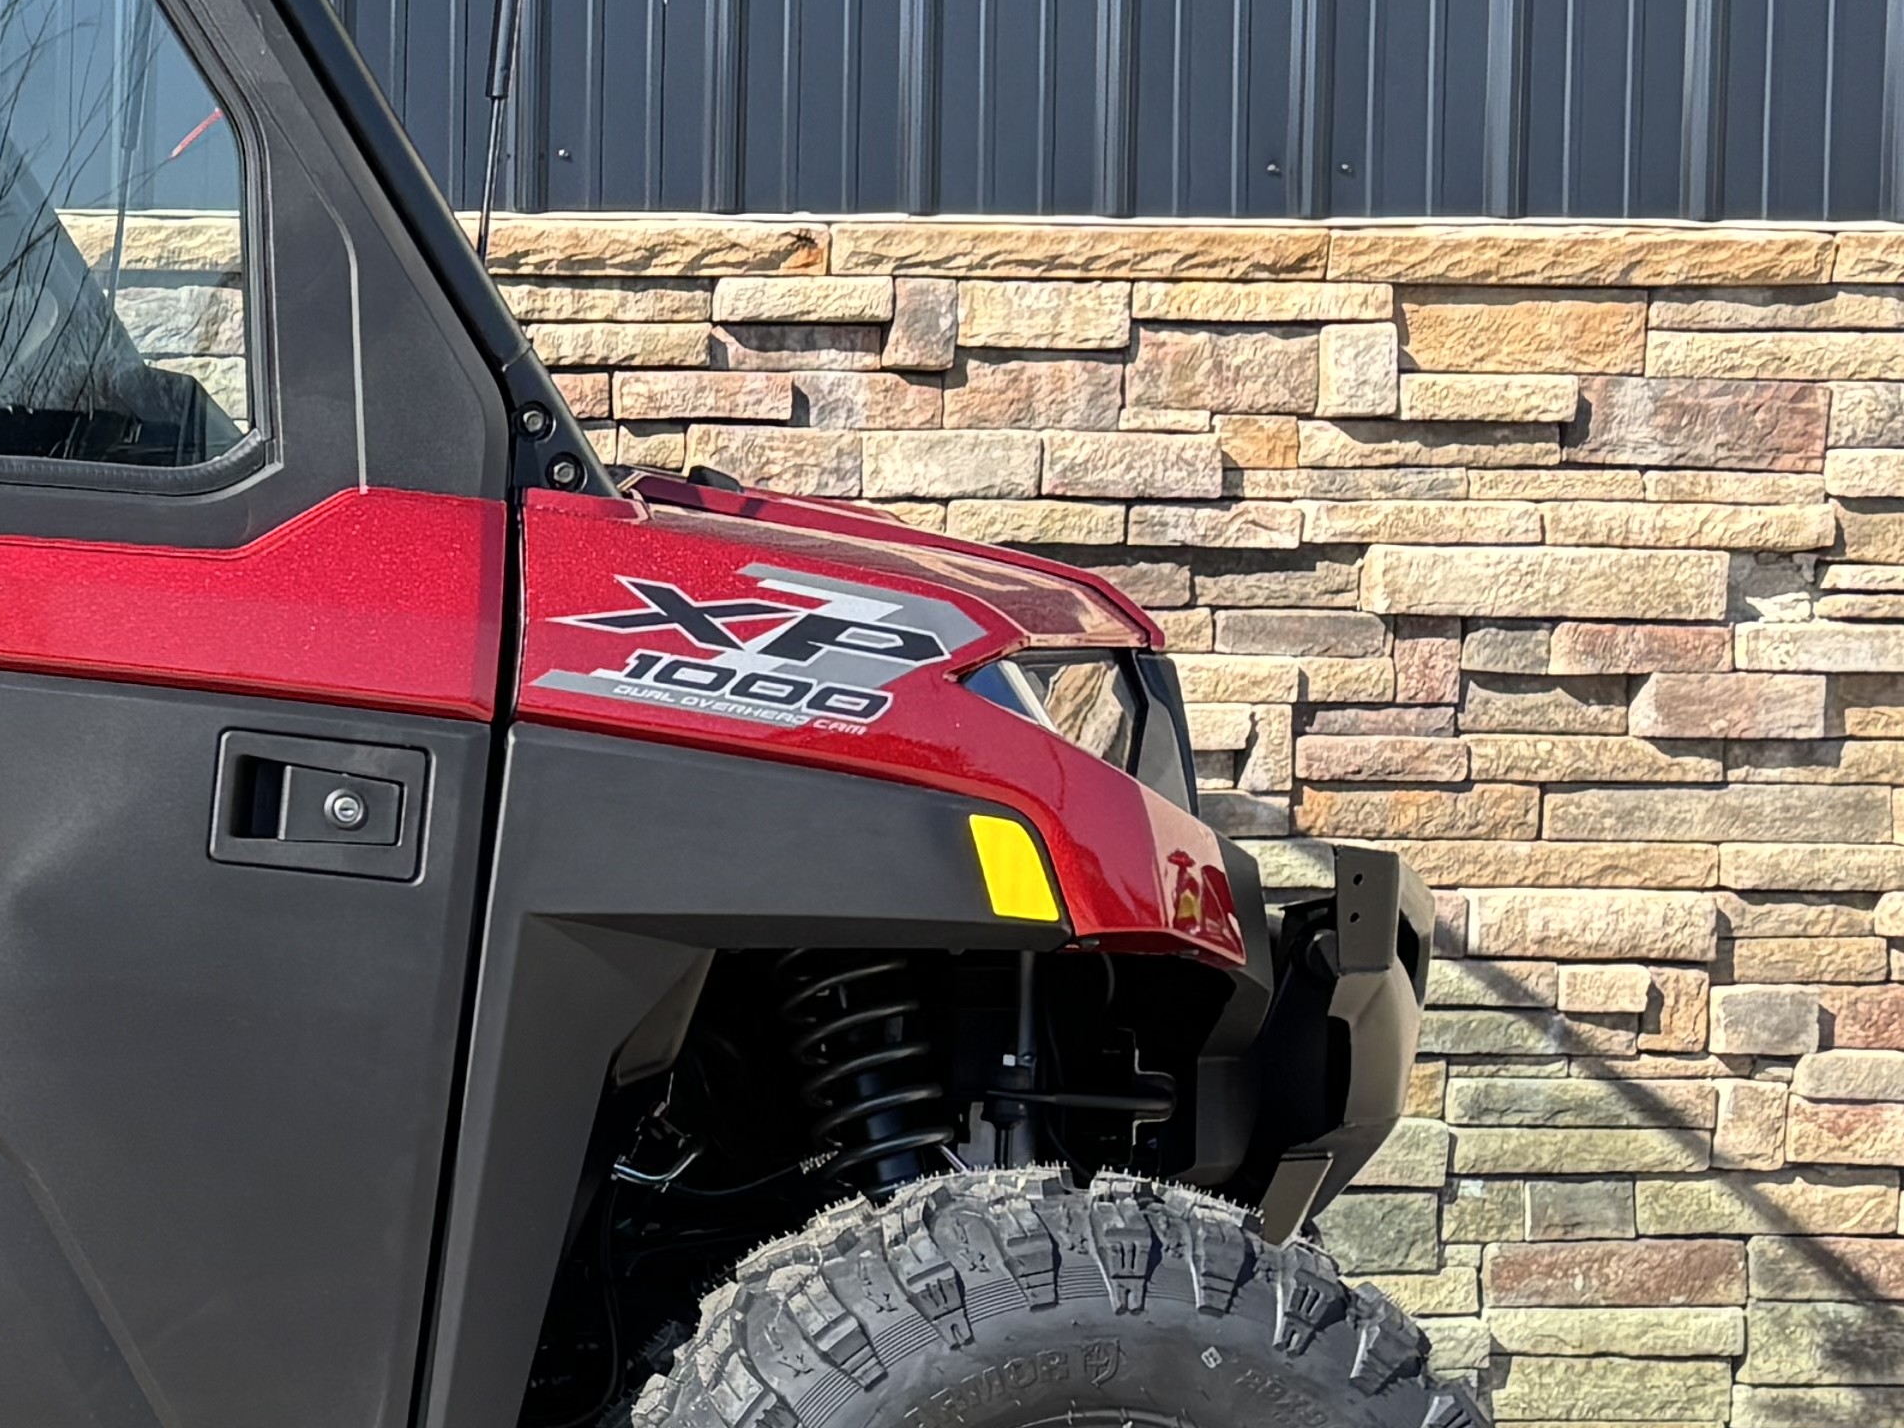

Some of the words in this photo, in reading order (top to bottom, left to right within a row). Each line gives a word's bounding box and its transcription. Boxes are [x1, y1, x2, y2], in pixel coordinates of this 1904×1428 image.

[545, 574, 952, 667] XP
[613, 685, 674, 702] DUAL
[680, 697, 811, 727] OVERHEAD
[812, 718, 869, 734] CAM
[623, 649, 893, 723] 1000
